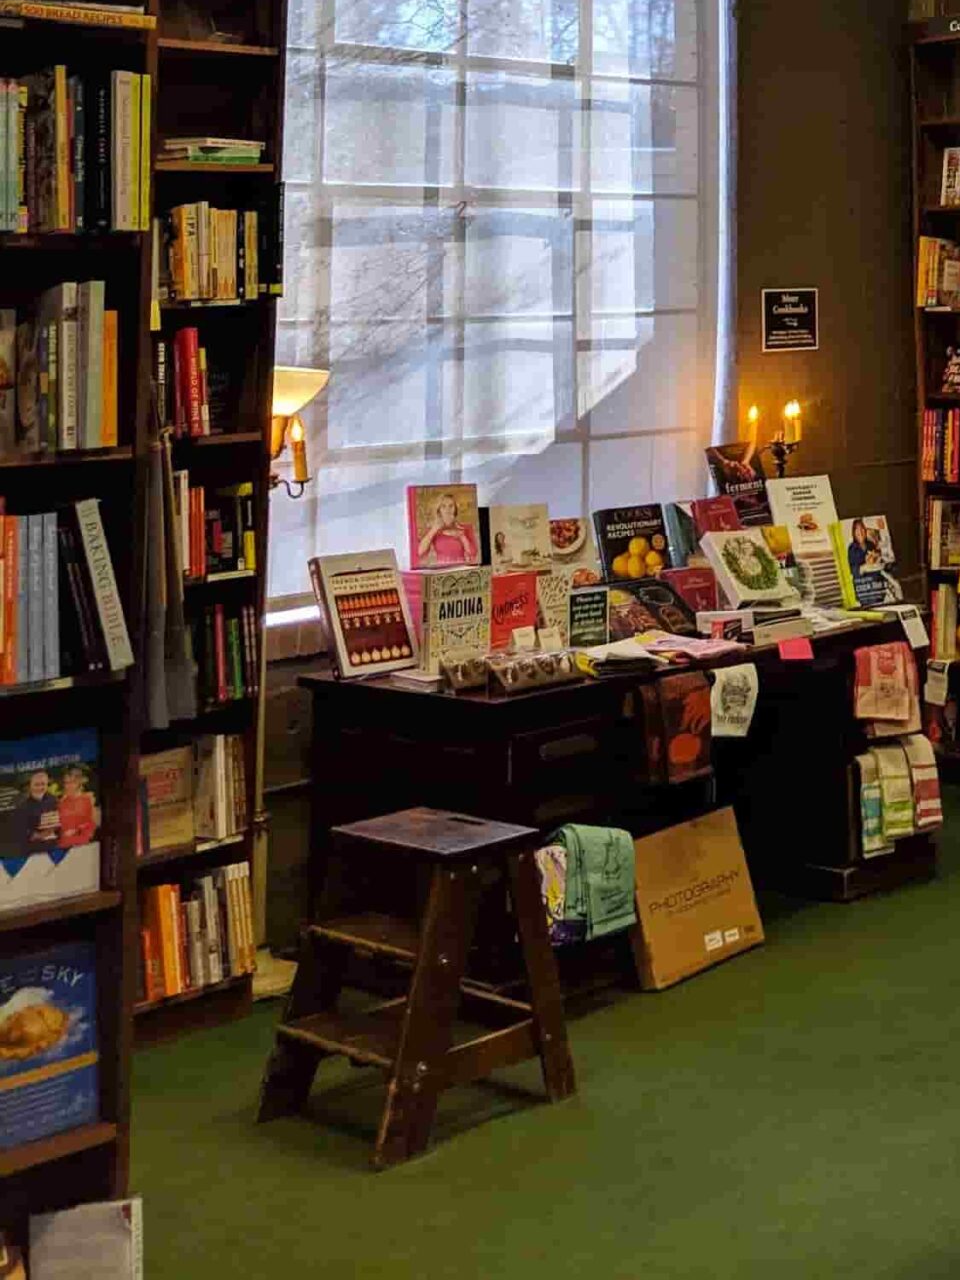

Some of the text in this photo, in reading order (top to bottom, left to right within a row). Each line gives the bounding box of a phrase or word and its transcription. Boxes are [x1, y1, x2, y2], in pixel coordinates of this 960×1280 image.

[84, 521, 126, 647] BAKING BIBLE
[438, 596, 484, 622] ANDINA
